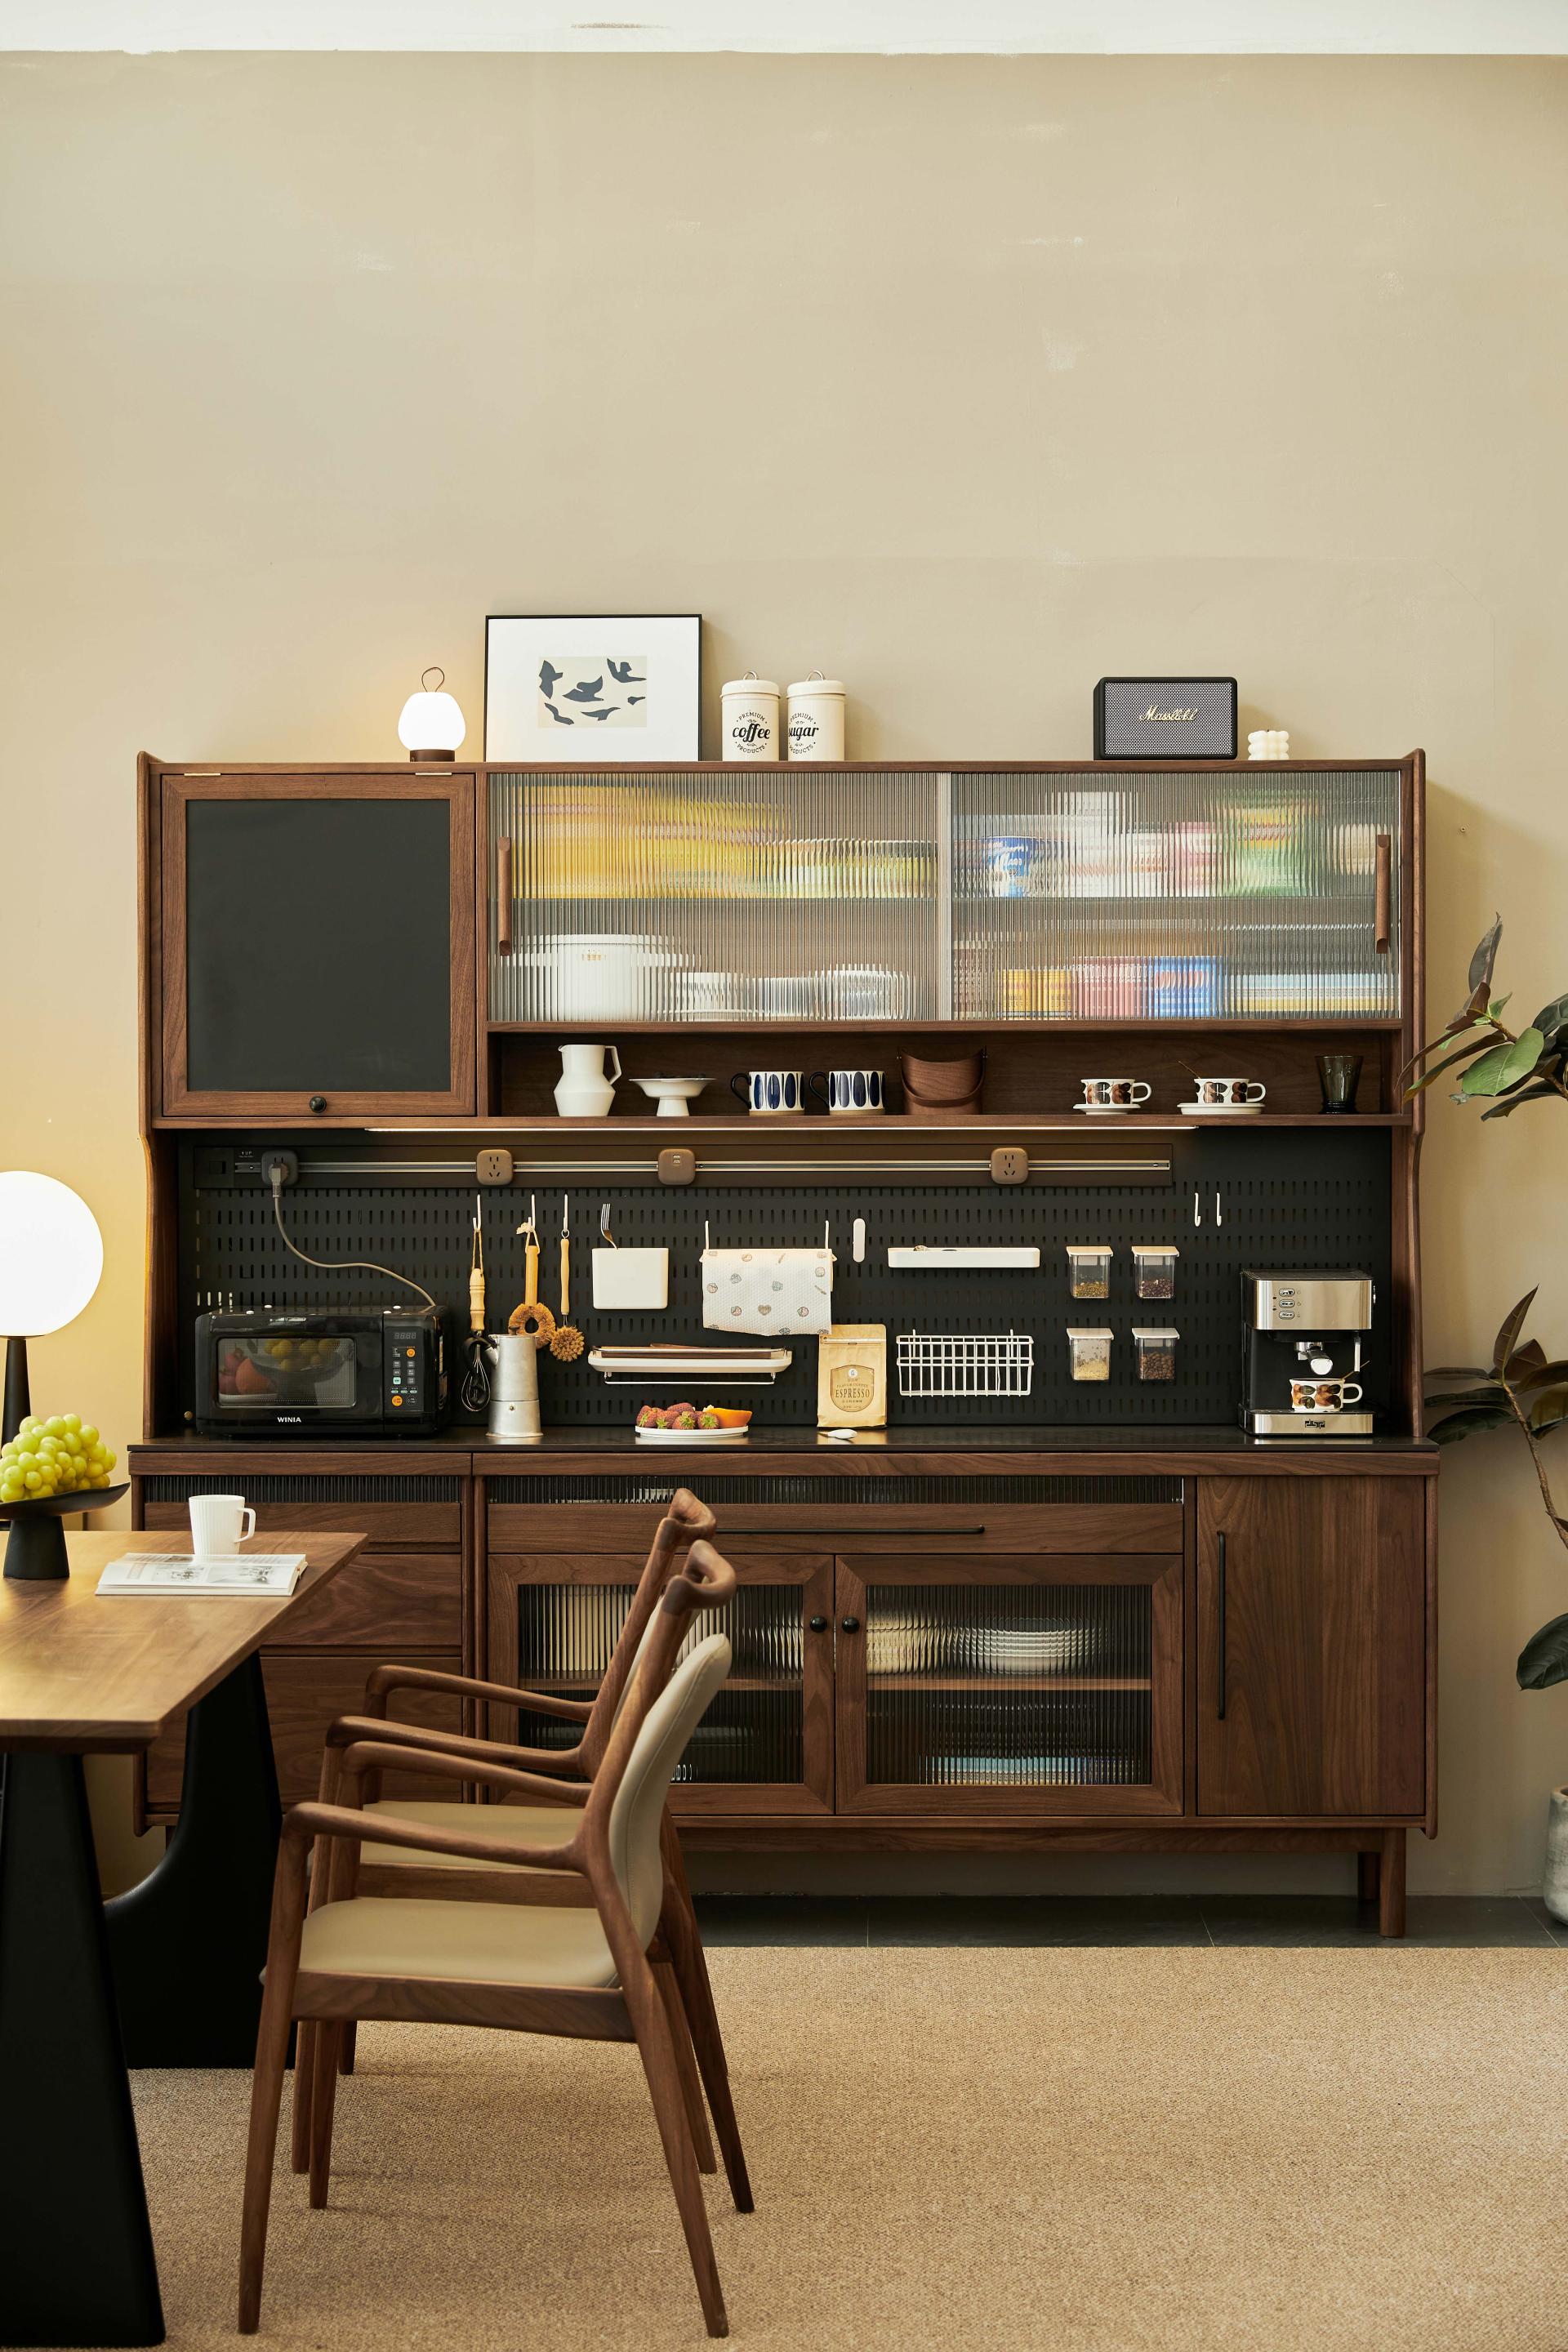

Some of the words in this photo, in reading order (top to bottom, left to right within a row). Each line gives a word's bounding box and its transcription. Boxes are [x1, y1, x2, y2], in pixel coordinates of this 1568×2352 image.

[738, 711, 765, 721] PREMIUM
[732, 723, 771, 743] coffee
[737, 743, 765, 754] PRODUCTS
[835, 1388, 870, 1398] ESPRESSO
